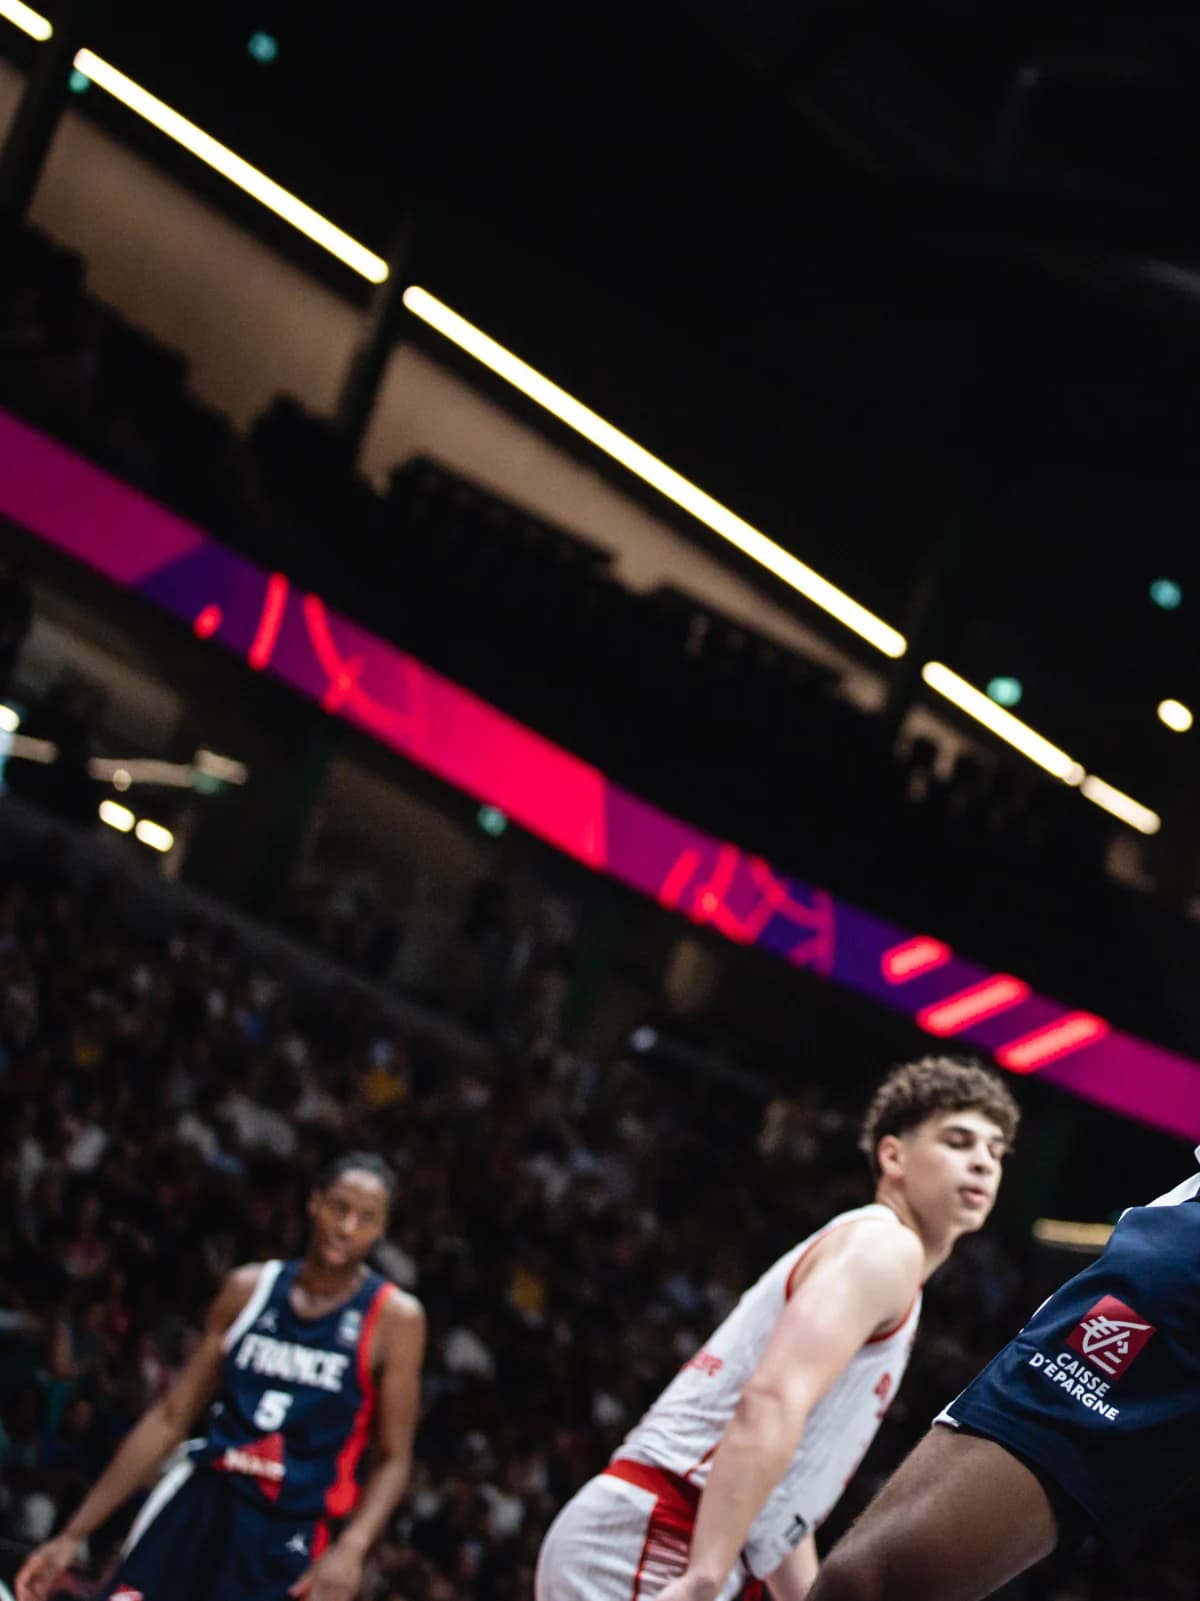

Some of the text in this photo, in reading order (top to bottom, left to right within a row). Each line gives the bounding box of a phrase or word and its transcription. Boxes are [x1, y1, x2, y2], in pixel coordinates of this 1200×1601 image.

[236, 1332, 349, 1393] FRANCE
[1056, 1353, 1111, 1397] CAISSE
[254, 1389, 294, 1431] 5
